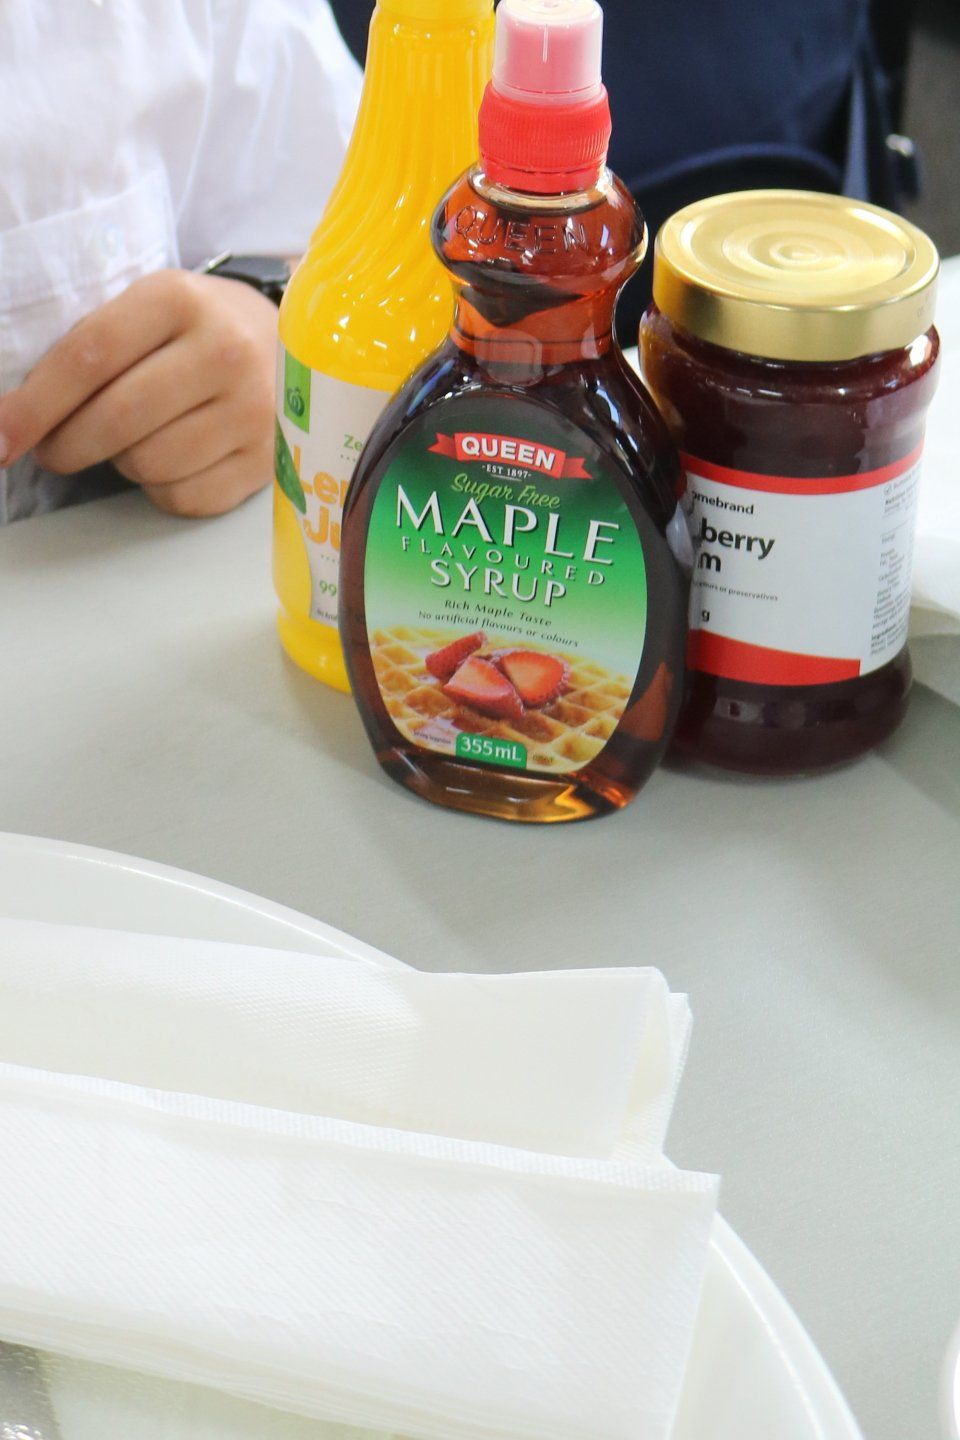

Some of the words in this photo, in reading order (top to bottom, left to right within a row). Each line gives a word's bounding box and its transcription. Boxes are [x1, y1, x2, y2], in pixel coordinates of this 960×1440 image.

[454, 206, 590, 255] QUEEN
[461, 435, 556, 471] QUEEN
[486, 464, 503, 475] EST
[507, 468, 528, 479] 1897
[451, 472, 514, 505] Sugar
[517, 484, 561, 509] Free
[396, 484, 621, 566] MAPLE
[700, 516, 776, 561] berry
[401, 535, 606, 587] FLAVOURED
[430, 559, 567, 607] SYRUP
[728, 588, 779, 602] preservatives
[434, 610, 479, 626] artificial
[481, 618, 523, 635] flavours
[525, 628, 538, 638] or
[540, 632, 580, 649] colours
[444, 598, 471, 611] Rich
[474, 603, 514, 619] Maple
[519, 611, 553, 628] Taste
[460, 735, 522, 762] 355mL
